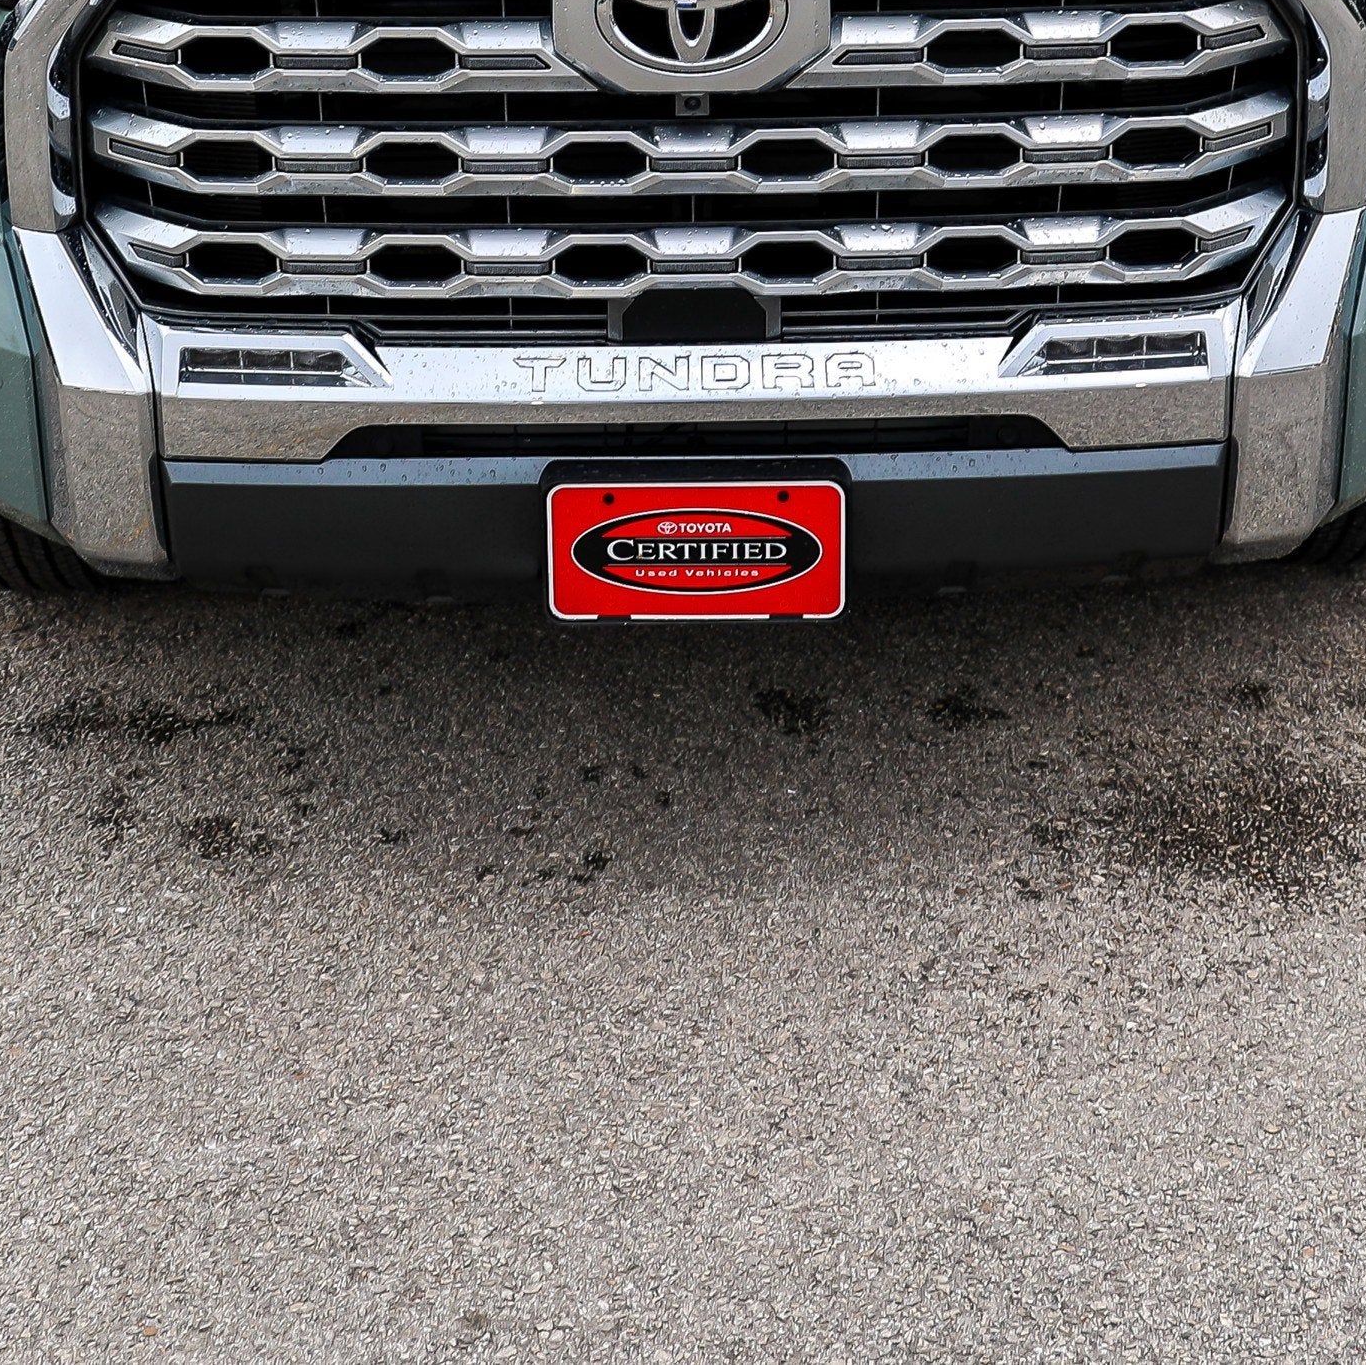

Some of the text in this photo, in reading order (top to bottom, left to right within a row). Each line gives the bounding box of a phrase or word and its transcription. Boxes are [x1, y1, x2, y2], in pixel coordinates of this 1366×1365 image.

[513, 352, 876, 392] TUNDRA
[679, 522, 732, 533] TOYOTA
[607, 539, 787, 561] CERTIFIED
[635, 568, 759, 577] Used Vehicles
